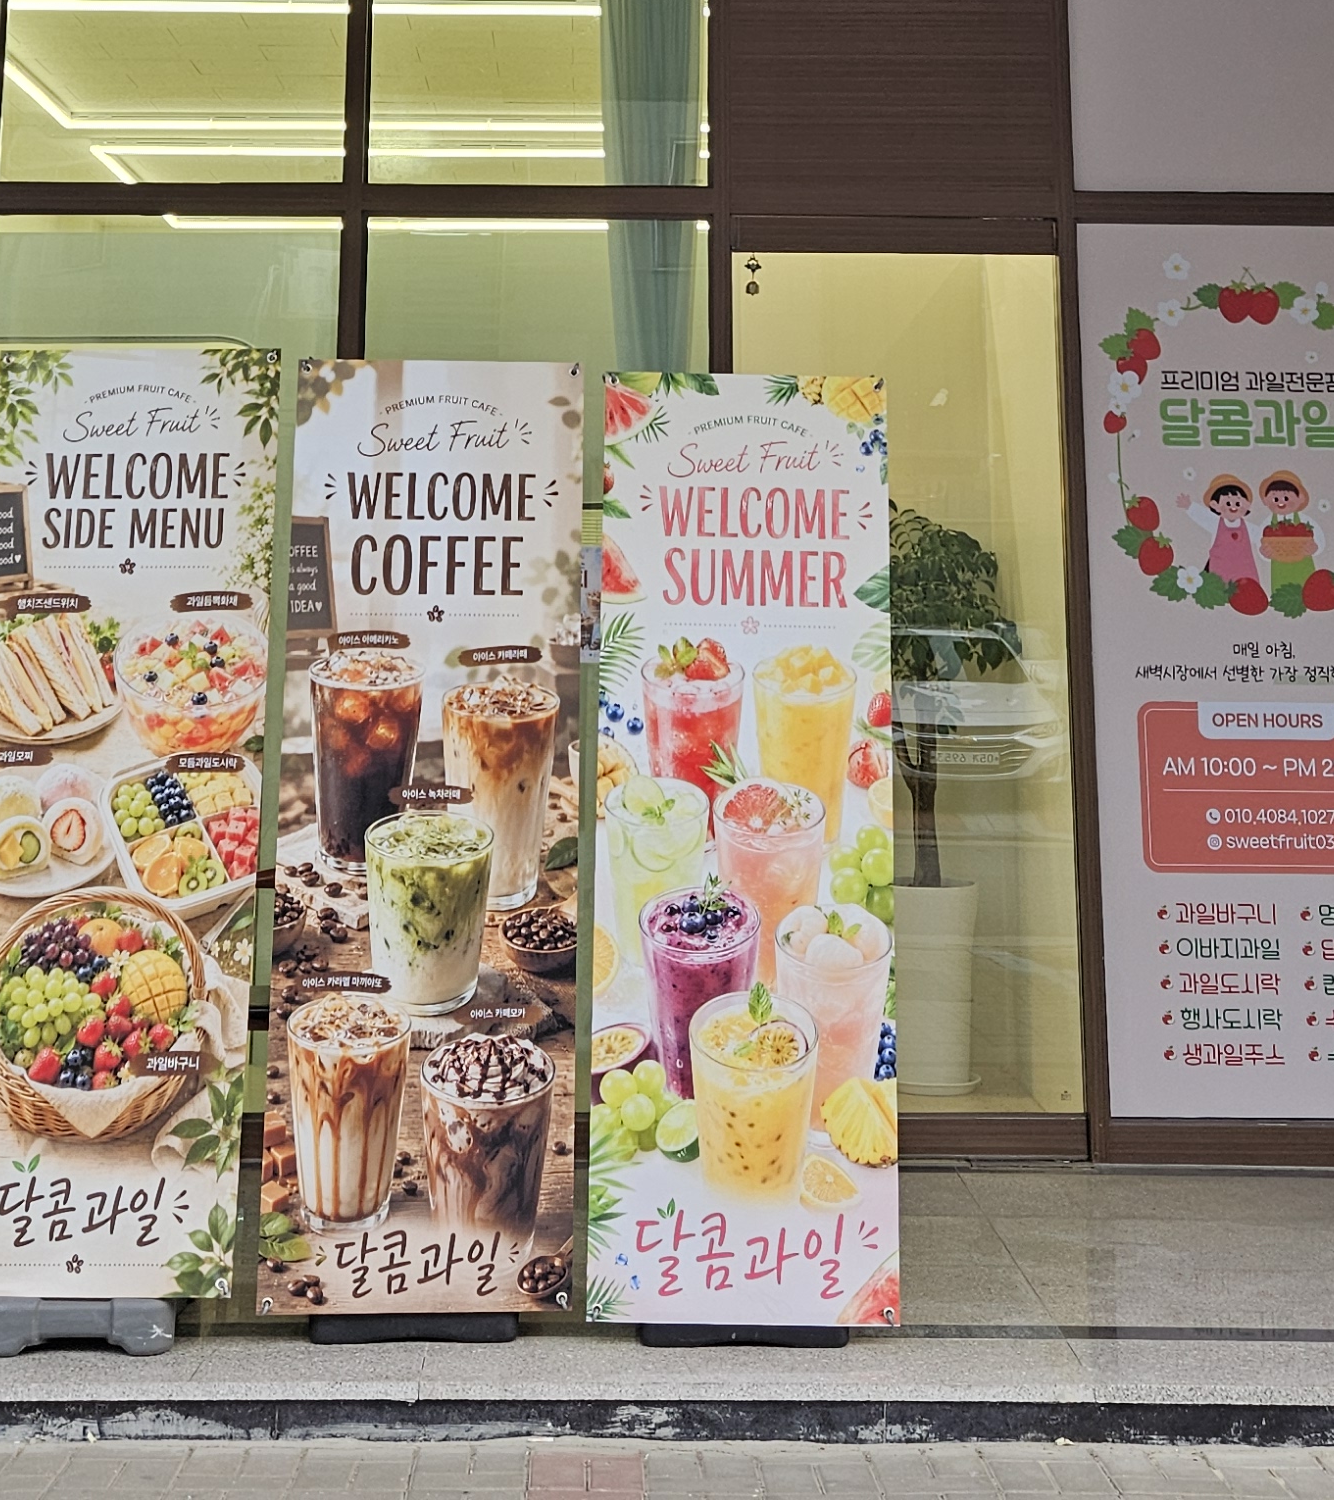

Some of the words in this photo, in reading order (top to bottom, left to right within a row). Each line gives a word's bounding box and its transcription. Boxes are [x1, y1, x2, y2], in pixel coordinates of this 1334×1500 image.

[1160, 369, 1240, 393] 프리미엄
[89, 384, 135, 403] PREMIUM
[137, 384, 166, 396] FRUIT
[168, 388, 193, 403] CAFE
[384, 395, 436, 415] PREMIUM
[438, 394, 469, 406] FRUIT
[471, 399, 498, 416] CAFE
[63, 411, 138, 442] Sweet
[145, 407, 202, 437] Fruit
[693, 415, 745, 435] PREMIUM
[746, 414, 778, 427] FRUIT
[780, 421, 809, 438] CAFE
[357, 423, 441, 457] Sweet
[449, 420, 510, 452] Fruit
[667, 443, 750, 478] Sweet
[759, 440, 822, 474] Fruit
[45, 452, 230, 499] WELCOME
[347, 472, 537, 521] WELCOME
[658, 485, 851, 541] WELCOME
[42, 507, 116, 549] SIDE
[129, 507, 225, 549] MENU
[351, 533, 524, 596] COFFEE
[296, 578, 317, 596] good
[662, 547, 849, 609] SUMMER
[290, 599, 315, 613] IDEA
[338, 635, 361, 646] 아이스
[362, 633, 399, 645] 아메리카노
[1232, 641, 1260, 658] 매일
[472, 650, 496, 662] 아이스
[1134, 664, 1218, 682] 새벽시장에서
[1222, 665, 1265, 683] 선별한
[1269, 666, 1297, 683] 가장
[1212, 712, 1259, 729] OPEN
[1263, 713, 1324, 729] HOURS
[1162, 756, 1196, 777] AM
[1200, 757, 1257, 777] 10:00
[1283, 758, 1316, 778] PM
[401, 788, 426, 800] 아이스
[1175, 902, 1277, 926] 과일바구니
[1176, 937, 1281, 961] 이바지과일
[302, 976, 325, 988] 아이스
[1178, 972, 1281, 996] 과일도시락
[470, 1008, 494, 1020] 아이스
[495, 1006, 526, 1019] 카페모카
[1180, 1007, 1283, 1032] 행사도시락
[145, 1055, 201, 1071] 과일바구니
[1182, 1043, 1286, 1067] 생과일주스
[334, 1229, 502, 1299] 달콤과일
[635, 1208, 845, 1300] 달콤과일
